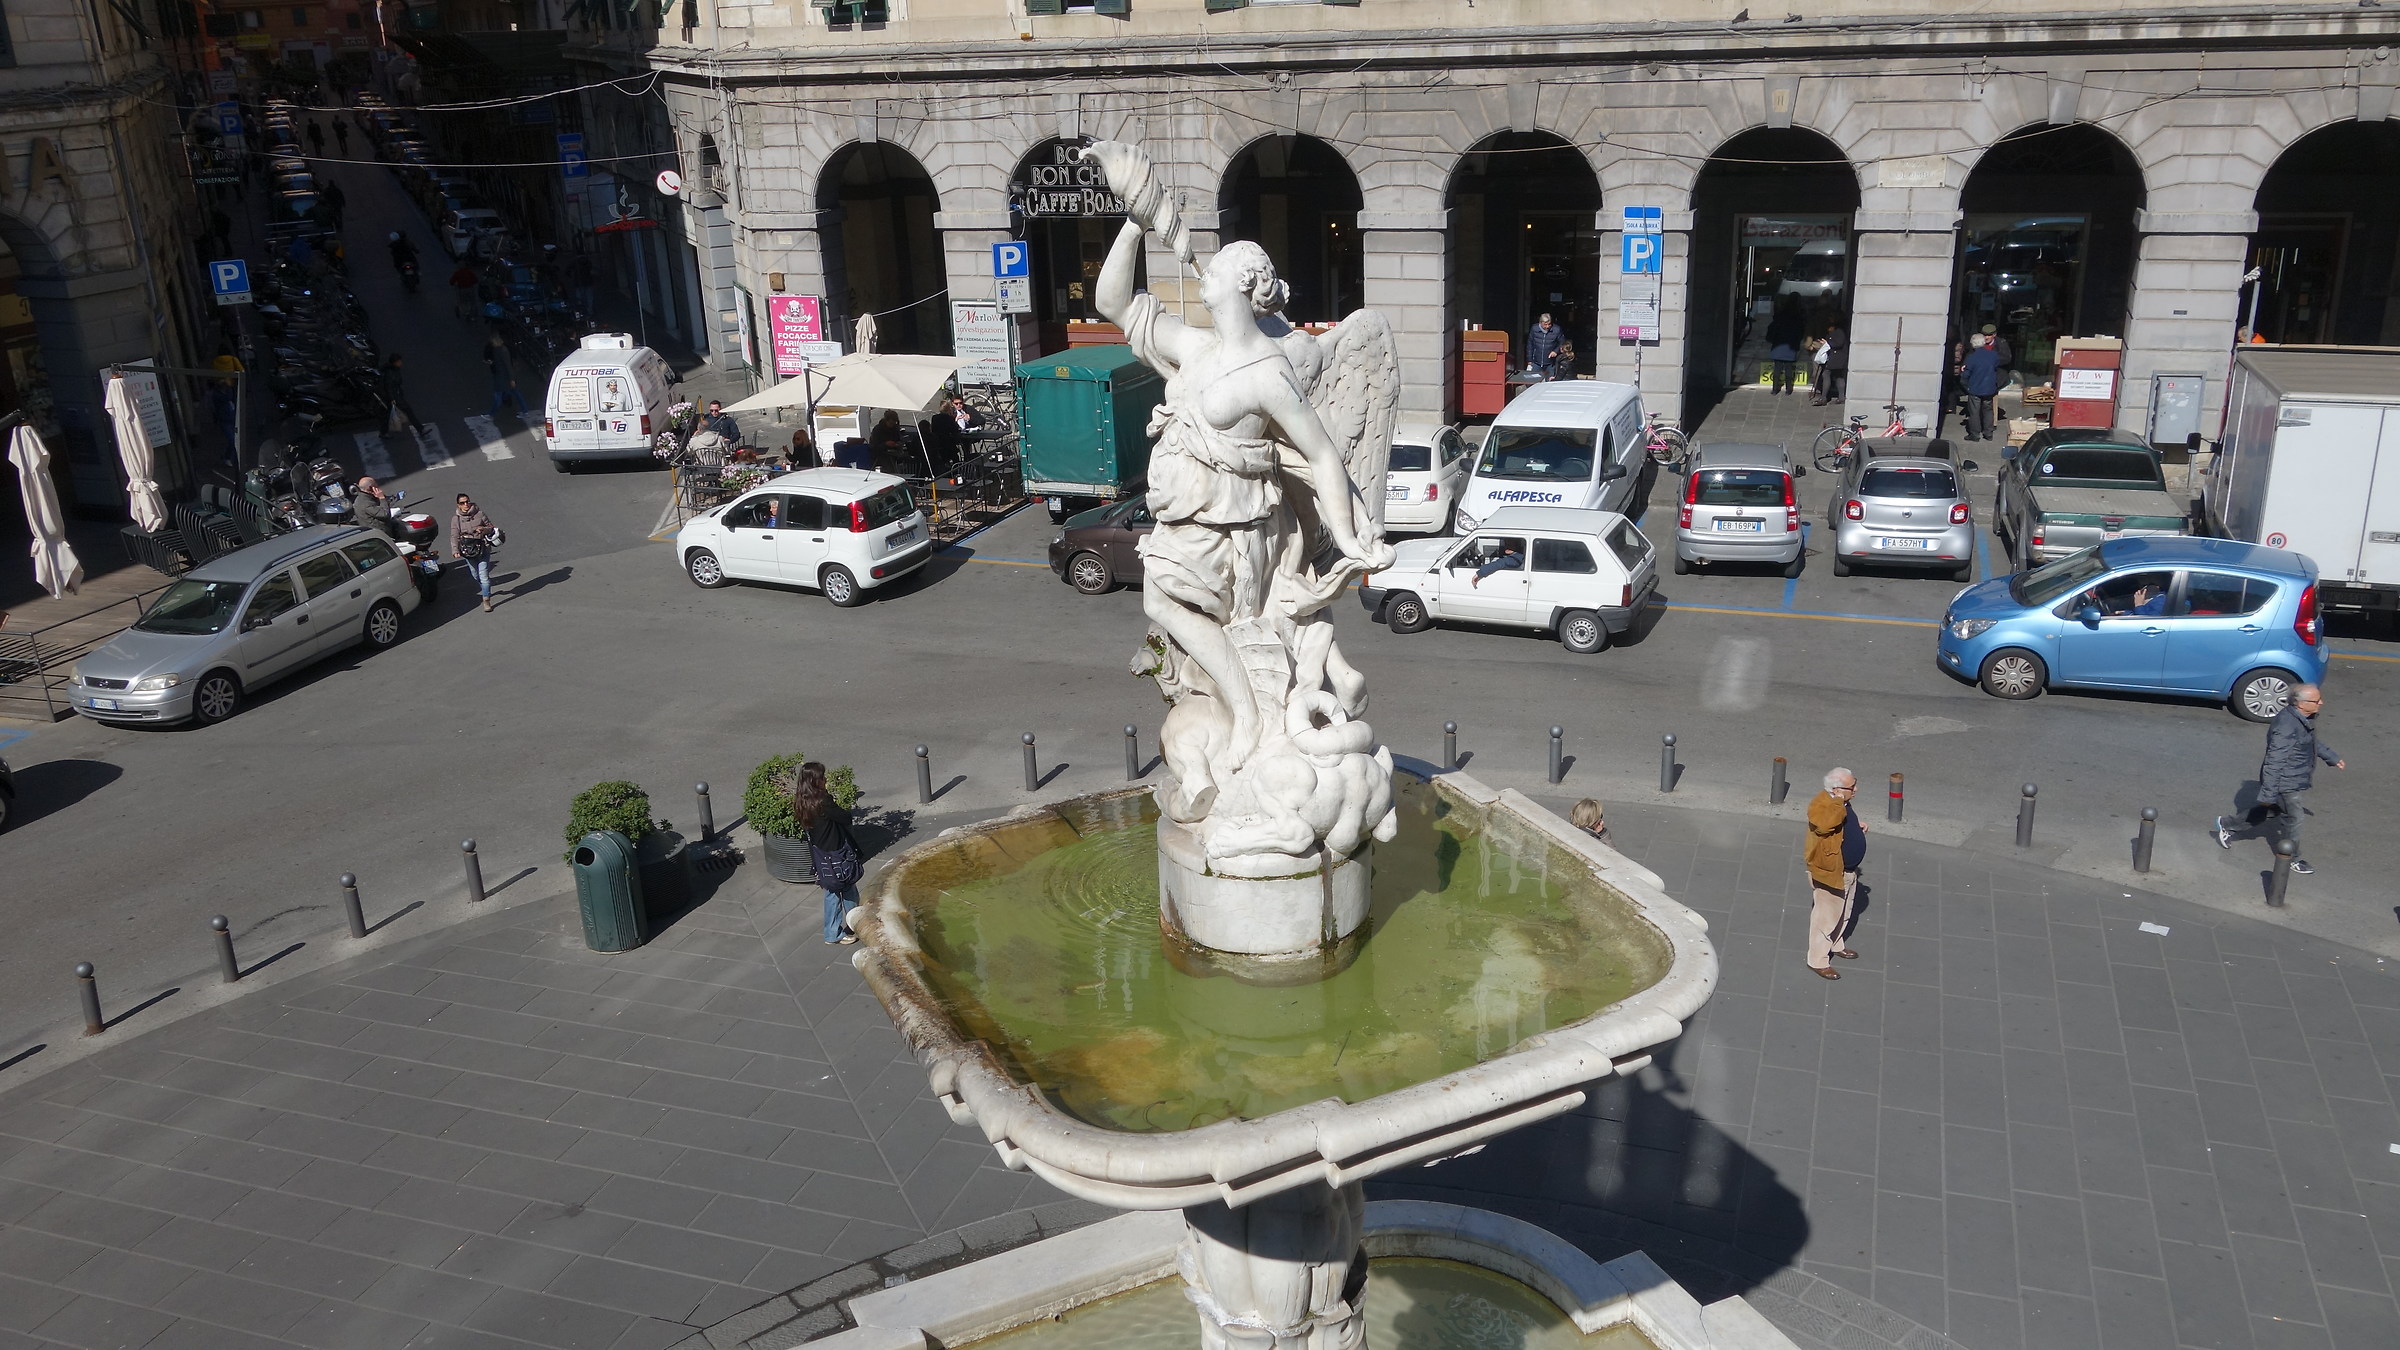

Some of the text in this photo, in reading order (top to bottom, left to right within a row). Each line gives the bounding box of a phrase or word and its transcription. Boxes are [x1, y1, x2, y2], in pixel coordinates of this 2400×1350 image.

[225, 116, 238, 132] P
[1032, 166, 1107, 186] BON CHI
[999, 245, 1022, 275] P
[1629, 237, 1655, 270] P
[218, 264, 240, 290] P
[957, 325, 1005, 335] investigazioni
[1487, 489, 1563, 504] ALFAPESCA
[1721, 521, 1758, 531] EB 169PW
[1886, 539, 1923, 548] FA 557HY
[2271, 537, 2282, 545] 80
